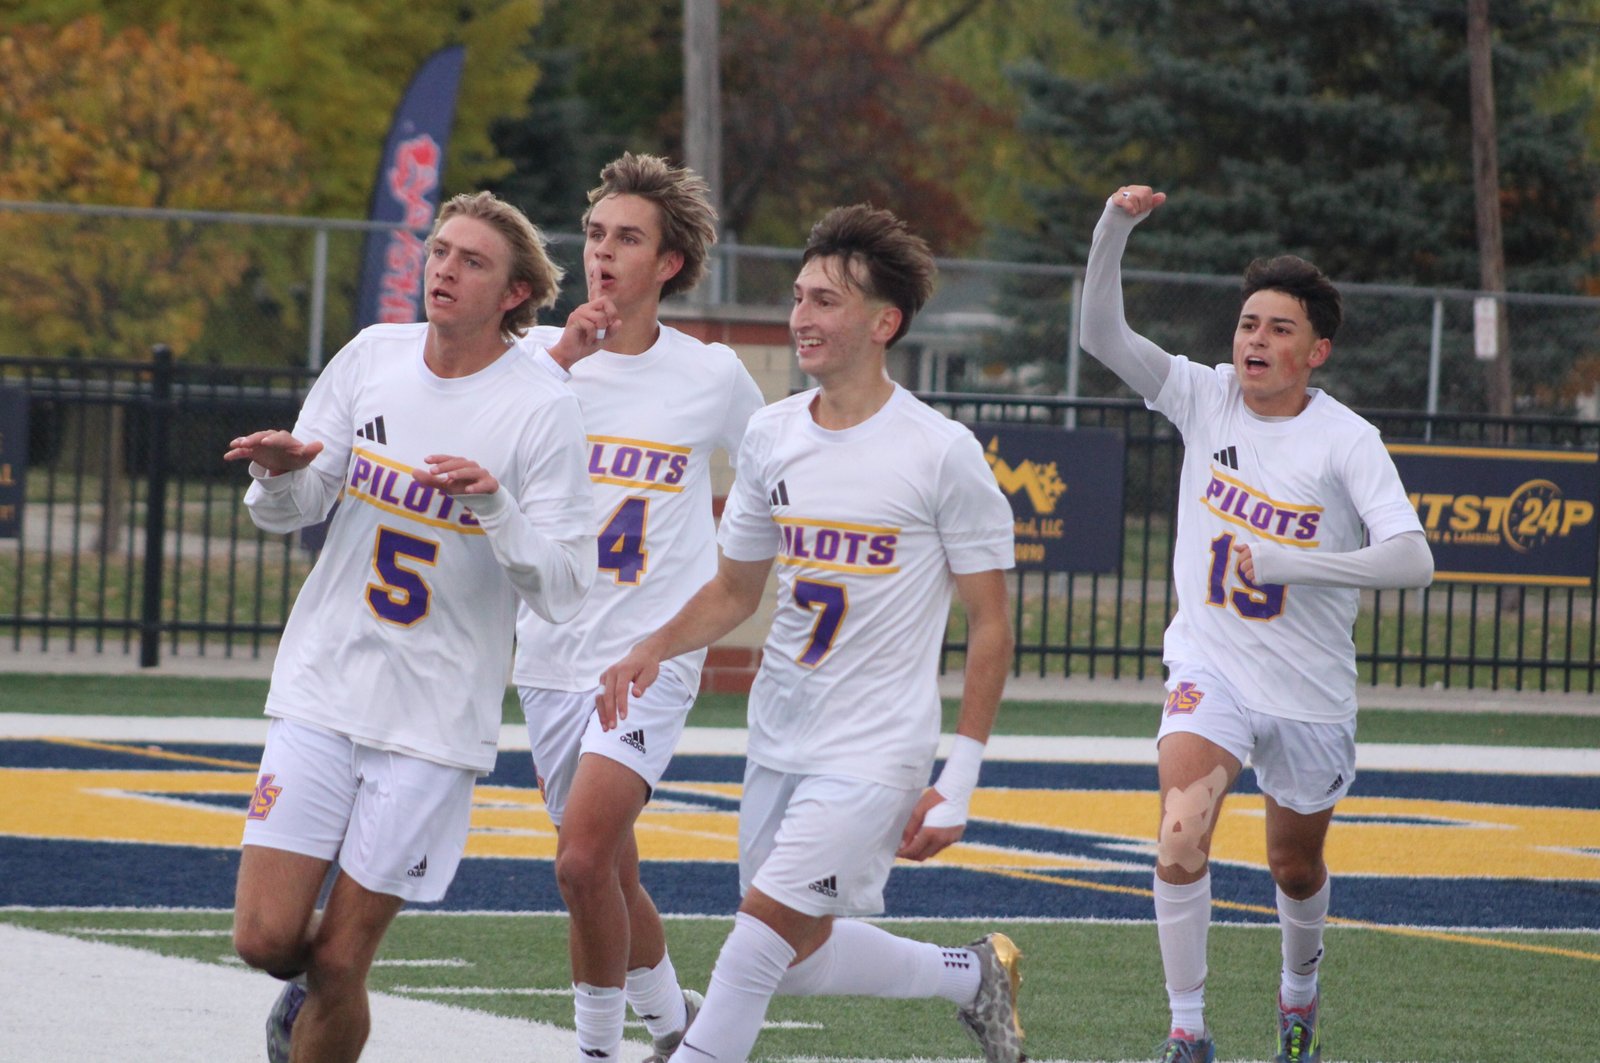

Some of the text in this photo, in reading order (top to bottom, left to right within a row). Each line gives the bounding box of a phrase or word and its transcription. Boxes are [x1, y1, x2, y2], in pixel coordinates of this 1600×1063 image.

[588, 443, 689, 485] LOTS
[1206, 476, 1320, 540] PILOTS
[598, 495, 650, 586] 4
[365, 524, 440, 628] 5
[793, 575, 849, 670] 7
[620, 735, 647, 754] adidas
[808, 883, 838, 898] adidas
